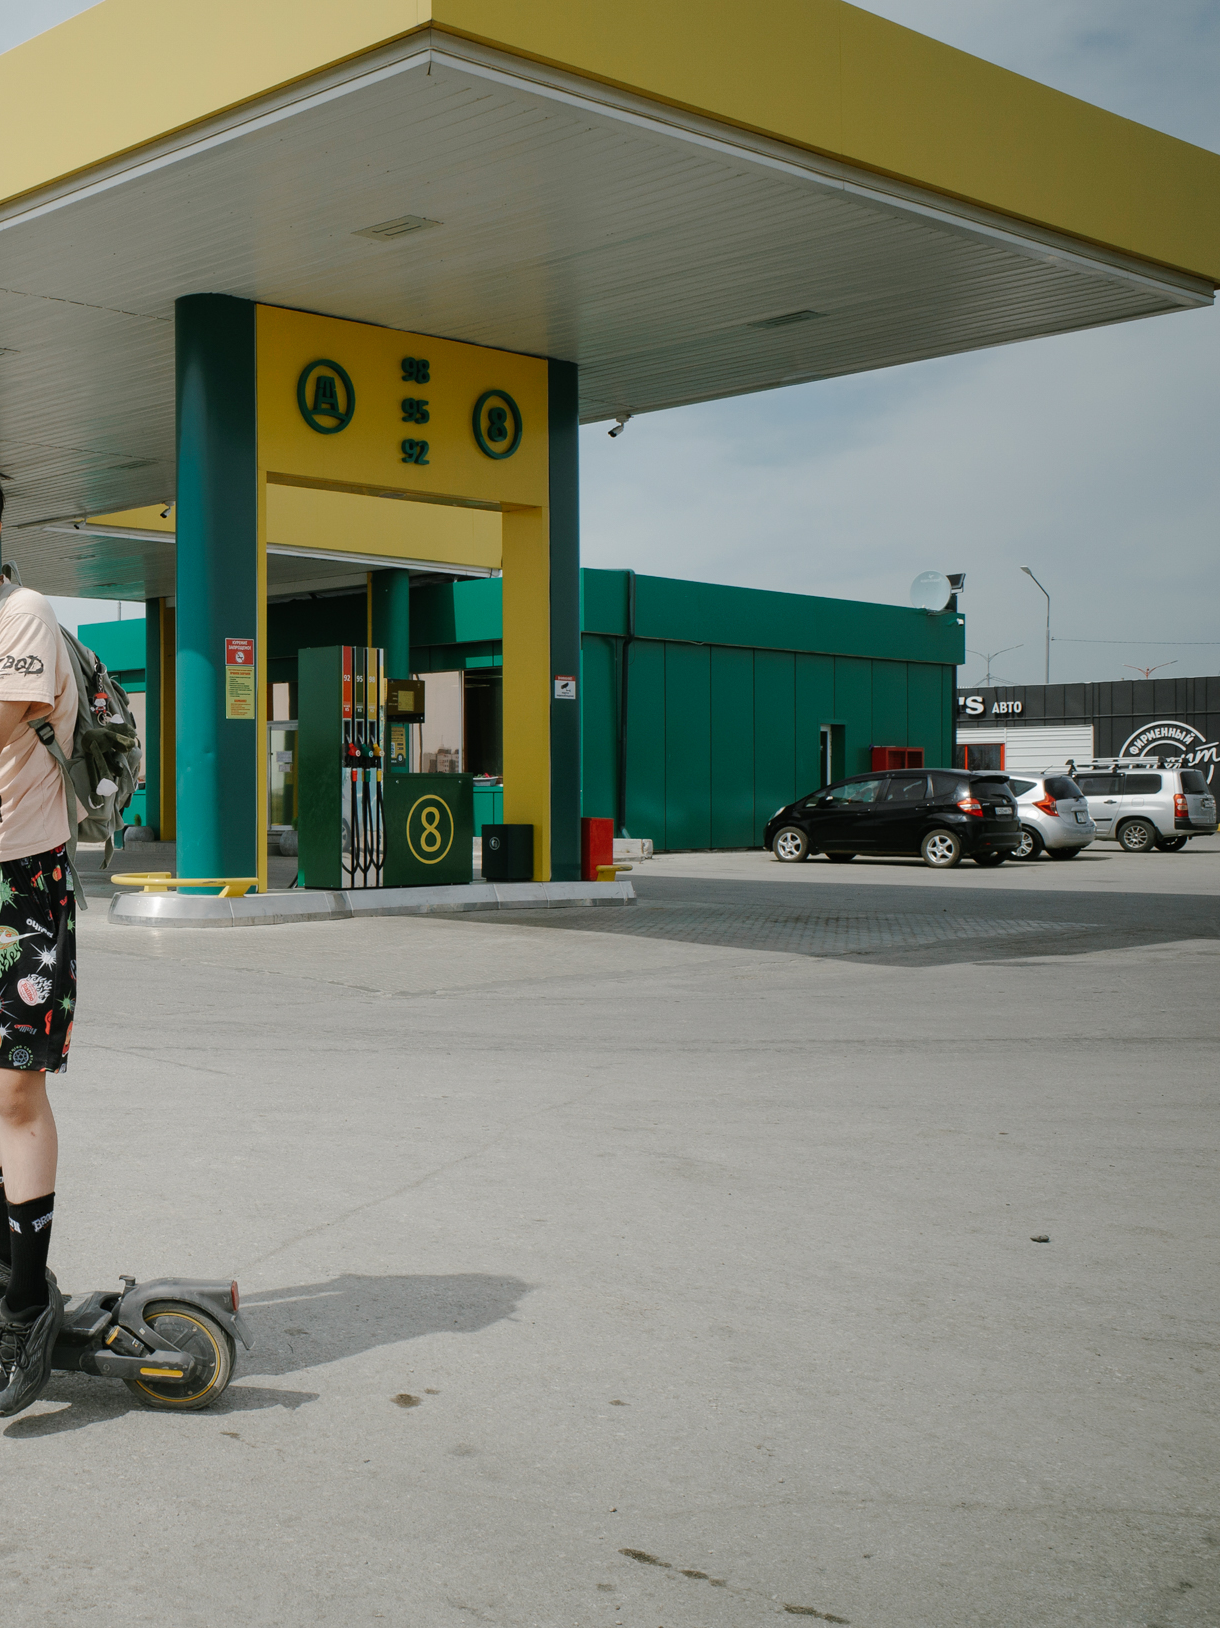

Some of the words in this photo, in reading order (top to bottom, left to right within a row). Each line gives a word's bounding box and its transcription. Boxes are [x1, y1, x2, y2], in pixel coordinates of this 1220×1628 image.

[401, 356, 430, 384] 98
[401, 397, 430, 424] 95
[487, 406, 508, 442] 8
[401, 438, 430, 465] 92
[343, 674, 351, 682] 92
[991, 701, 1023, 714] АВТО
[1129, 726, 1196, 755] ФИРМЕННЫЙ
[420, 806, 442, 853] 8
